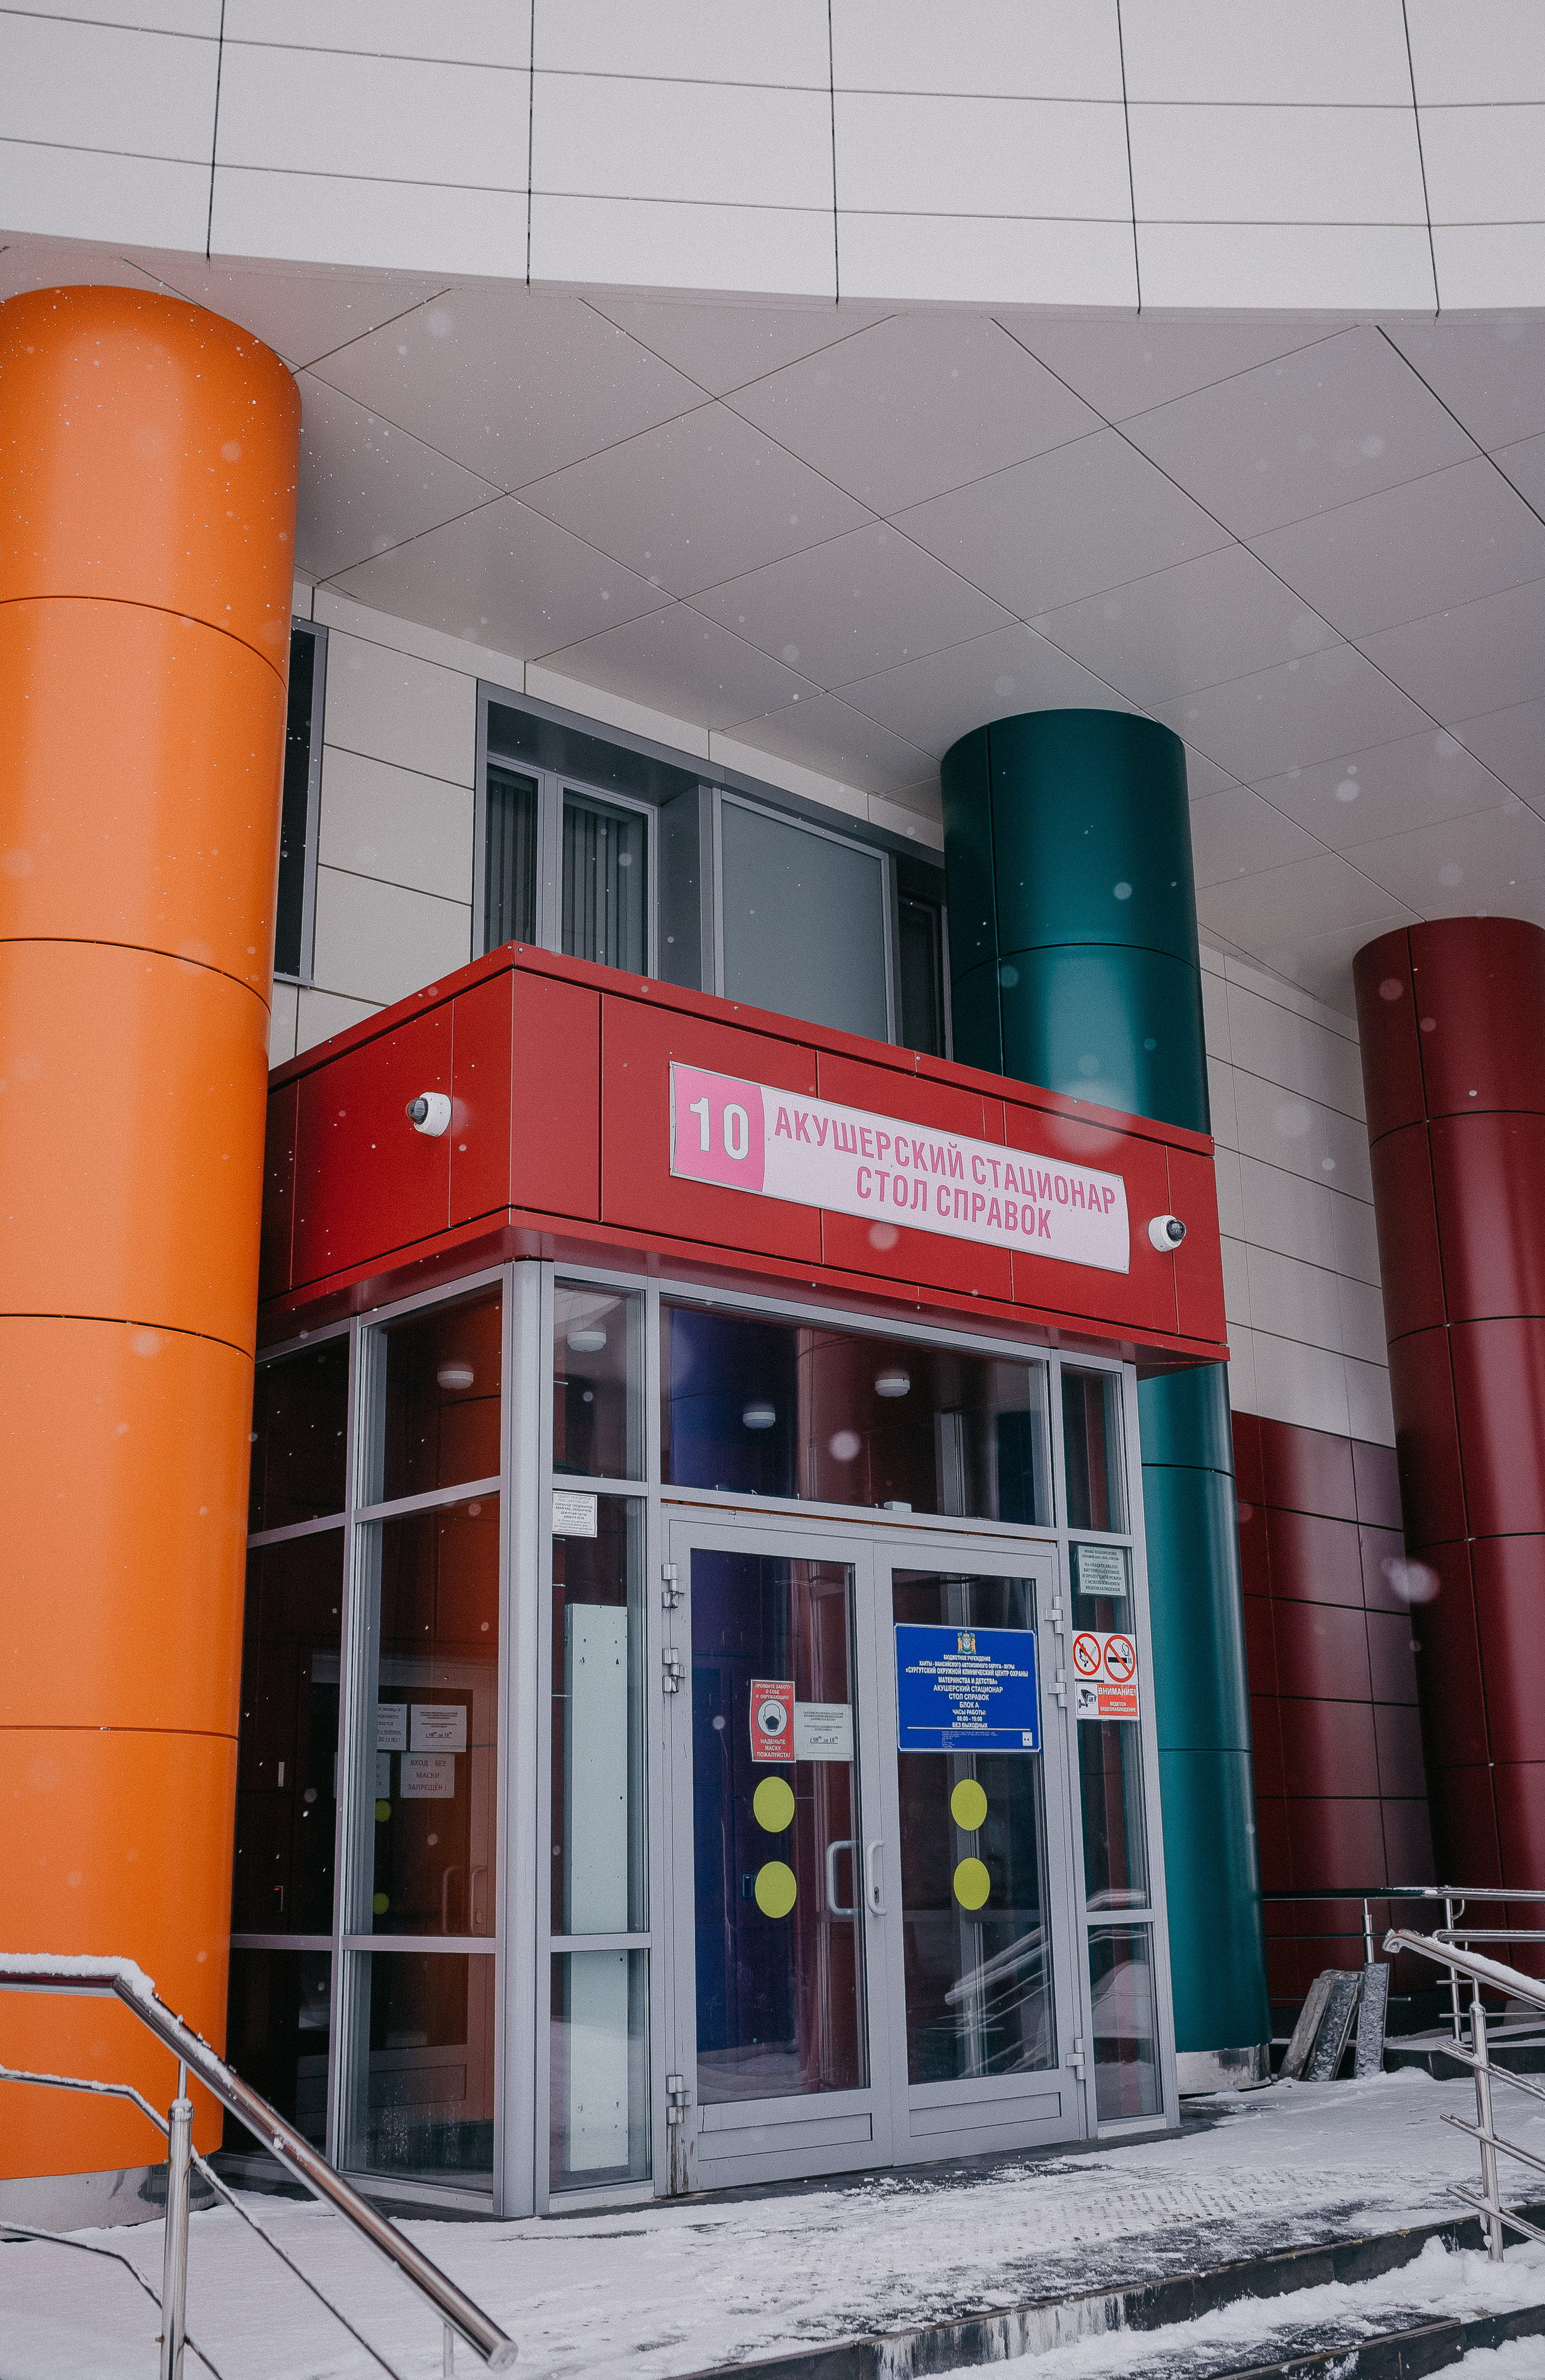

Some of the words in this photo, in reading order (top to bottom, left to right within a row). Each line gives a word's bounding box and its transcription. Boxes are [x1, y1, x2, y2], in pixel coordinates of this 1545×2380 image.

[689, 1096, 749, 1161] 10
[774, 1106, 964, 1181] АКУШЕРСКИЙ
[972, 1155, 1116, 1215] СТАЦИОНАР
[856, 1166, 928, 1211] СТОЛ
[936, 1184, 1053, 1240] СПРАВОК
[1098, 1687, 1136, 1696] ВНИМАНИЕ!
